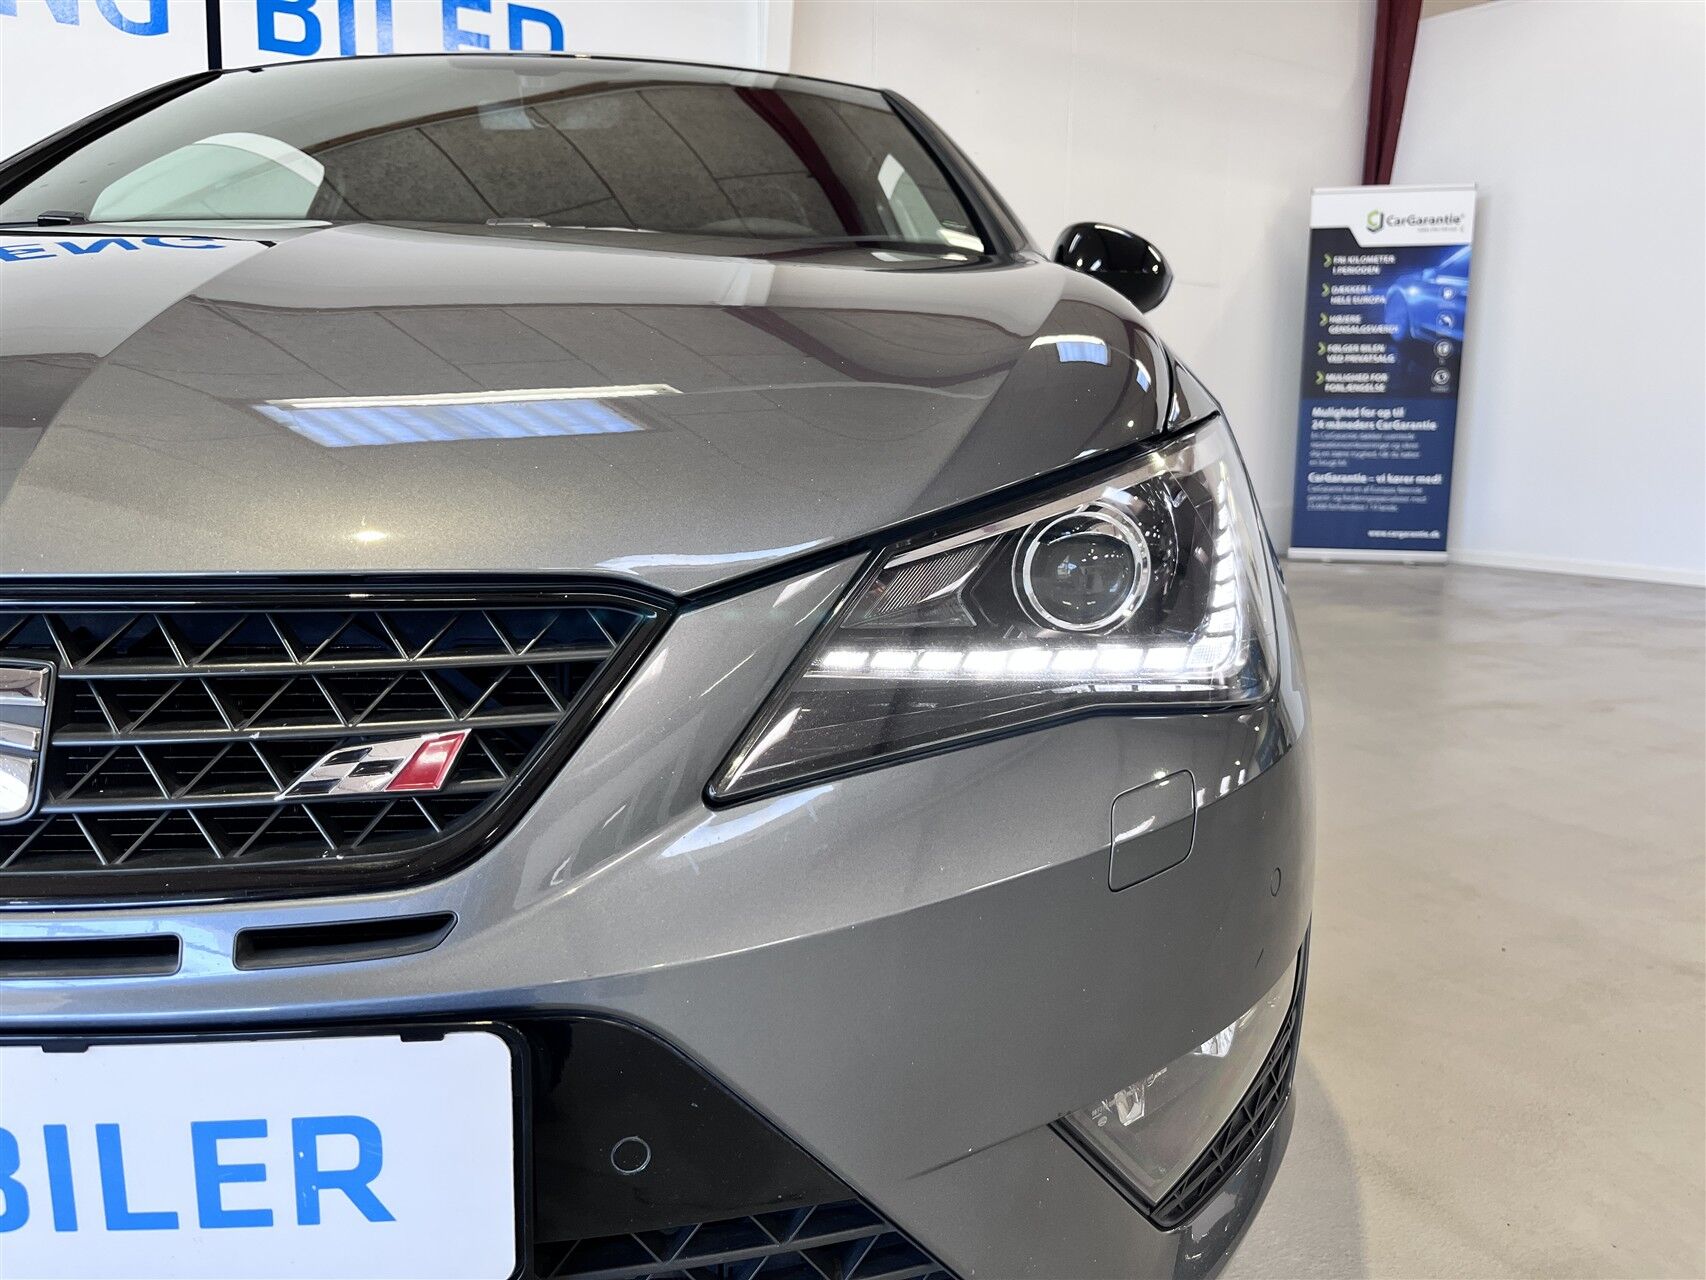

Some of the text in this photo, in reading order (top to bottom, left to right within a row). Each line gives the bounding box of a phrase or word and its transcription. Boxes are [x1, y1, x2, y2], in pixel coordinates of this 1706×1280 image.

[1347, 254, 1396, 264] KILOMETER
[1337, 266, 1380, 275] PERIODEN
[1330, 295, 1386, 305] HELE EUROPA
[1360, 343, 1386, 353] BILEN
[1326, 354, 1344, 363] VED
[1325, 373, 1388, 382] MULIGHED FOR
[1312, 407, 1405, 419] Mulighed for op til
[1376, 419, 1438, 431] CarGarantie
[1308, 472, 1367, 483] CarGarantie
[1375, 473, 1386, 484] vi
